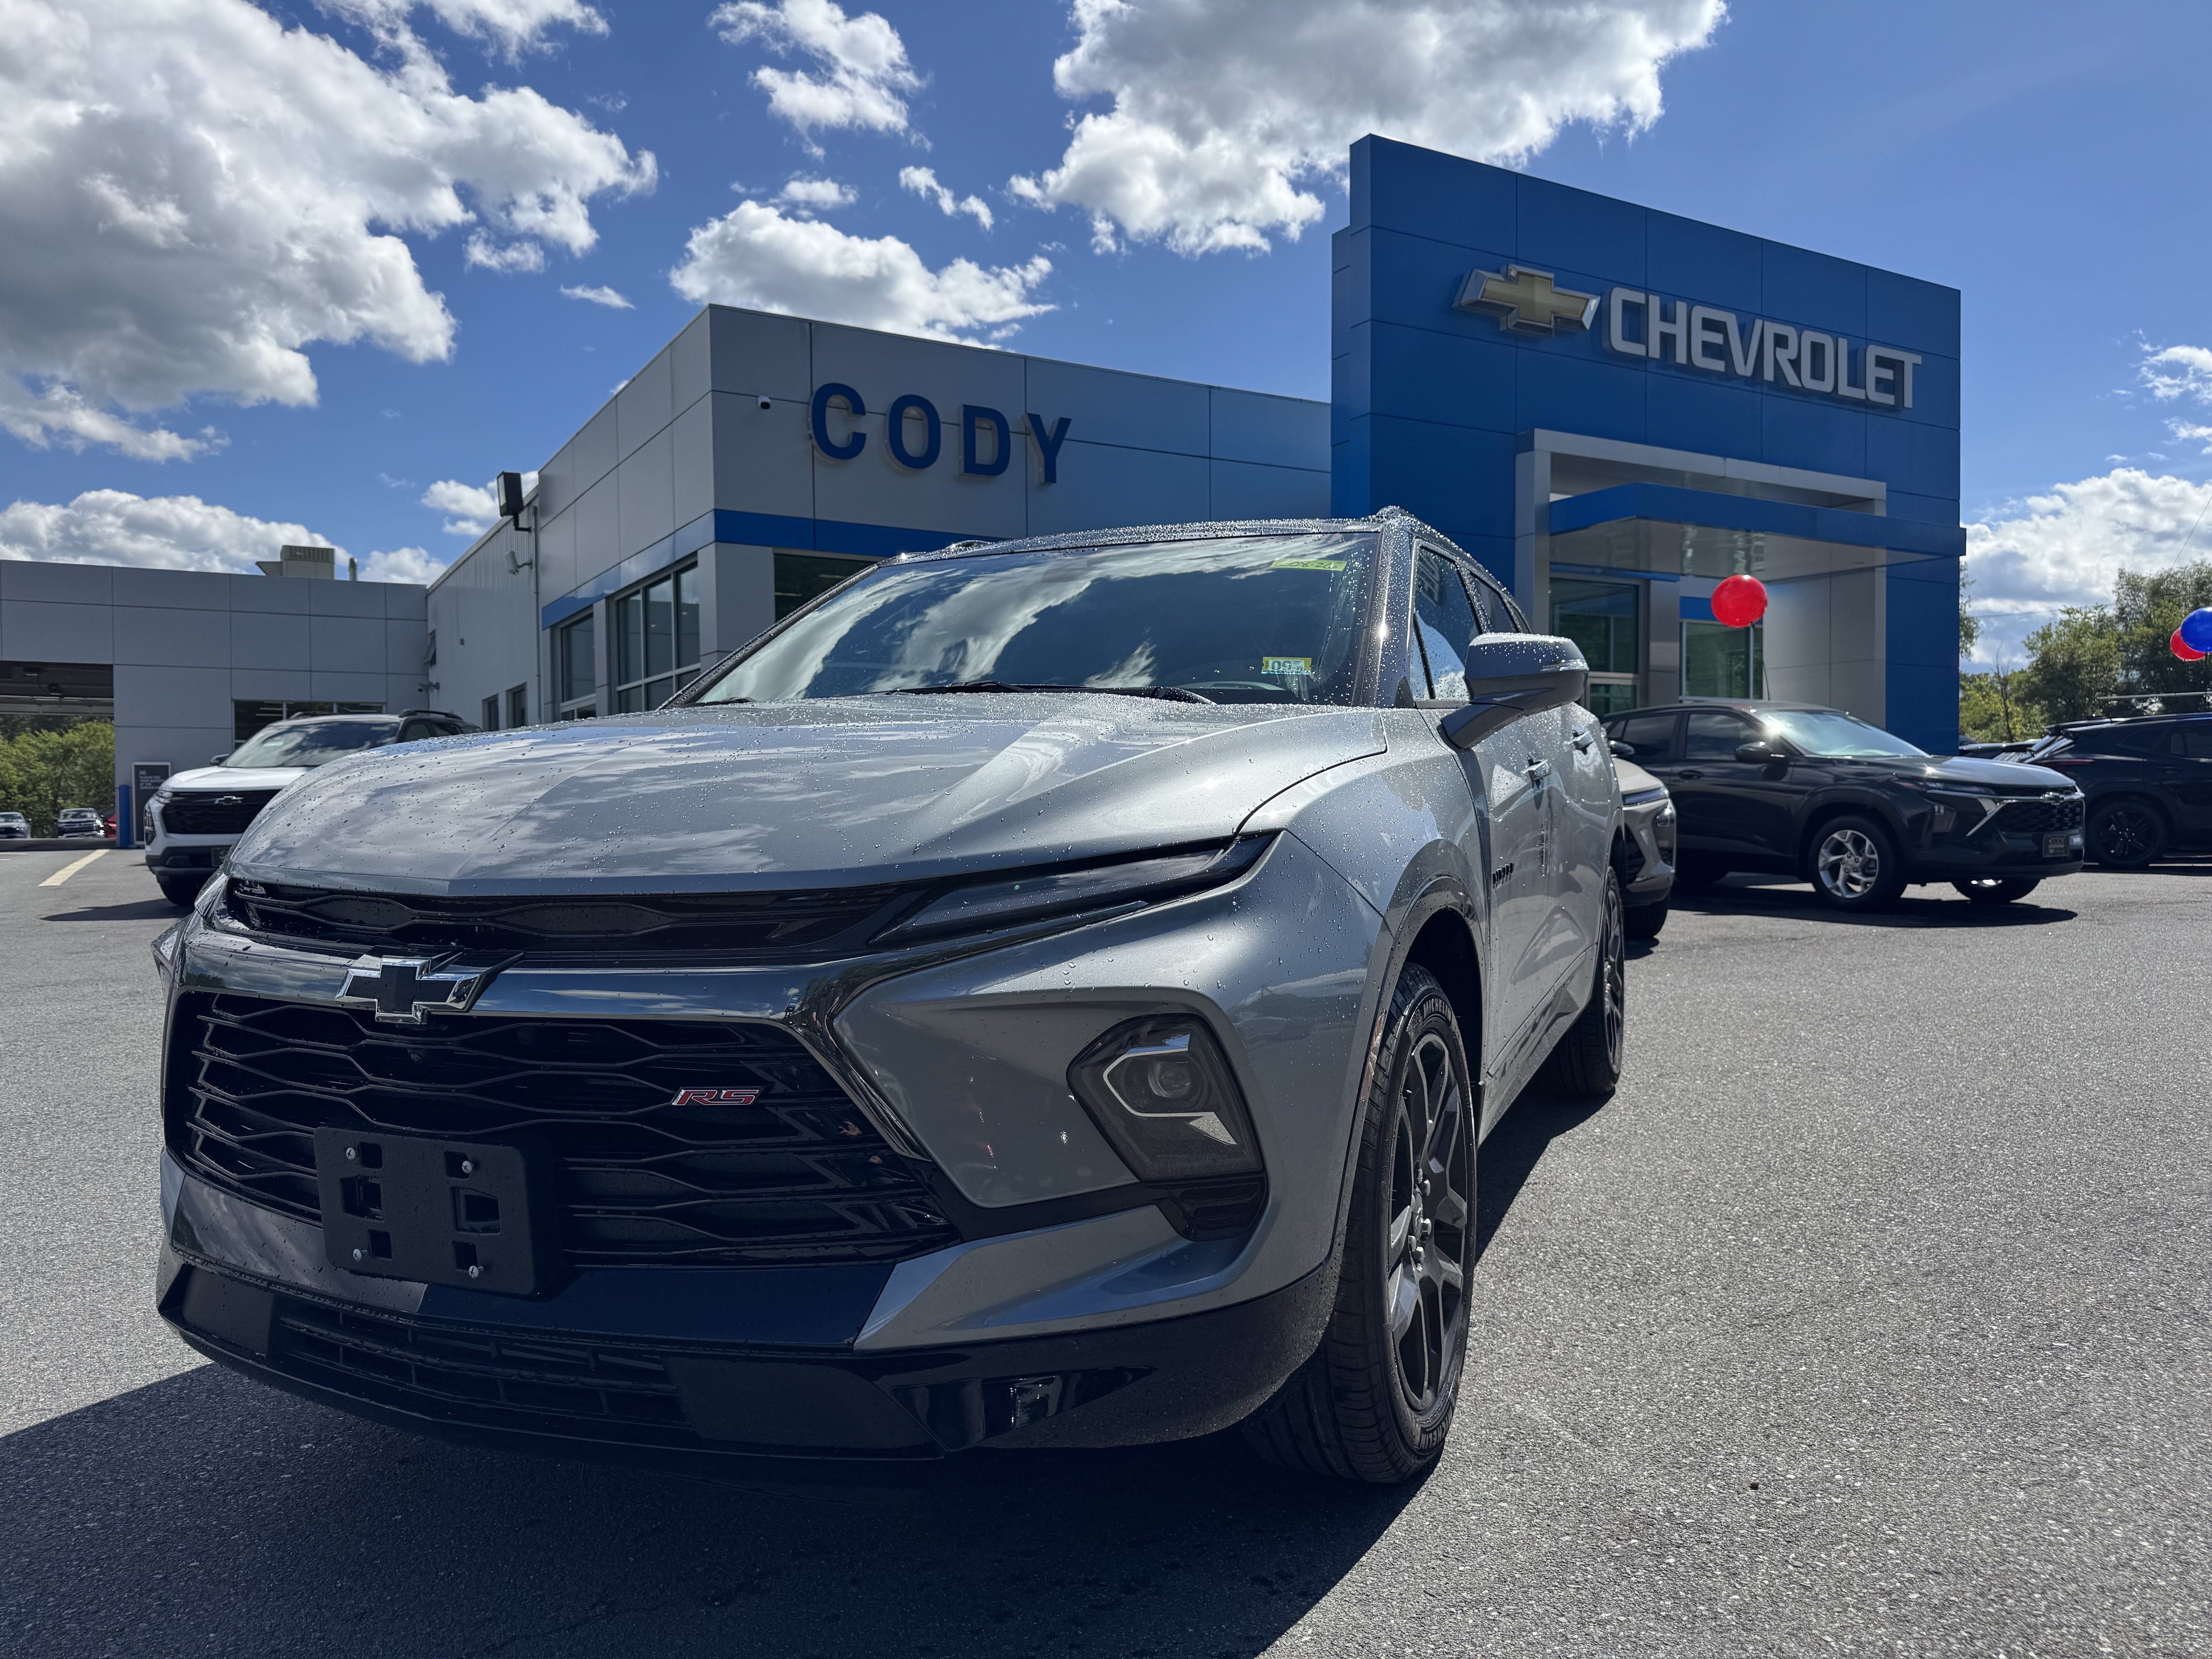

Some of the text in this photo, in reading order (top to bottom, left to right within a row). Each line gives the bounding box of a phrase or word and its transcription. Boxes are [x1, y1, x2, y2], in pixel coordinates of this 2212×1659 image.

[1609, 286, 1922, 409] CHEVROLET
[810, 383, 1072, 484] CODY
[1423, 998, 1451, 1022] MICHELIN
[672, 1089, 759, 1105] RS
[1420, 1406, 1452, 1449] MICHELIN
